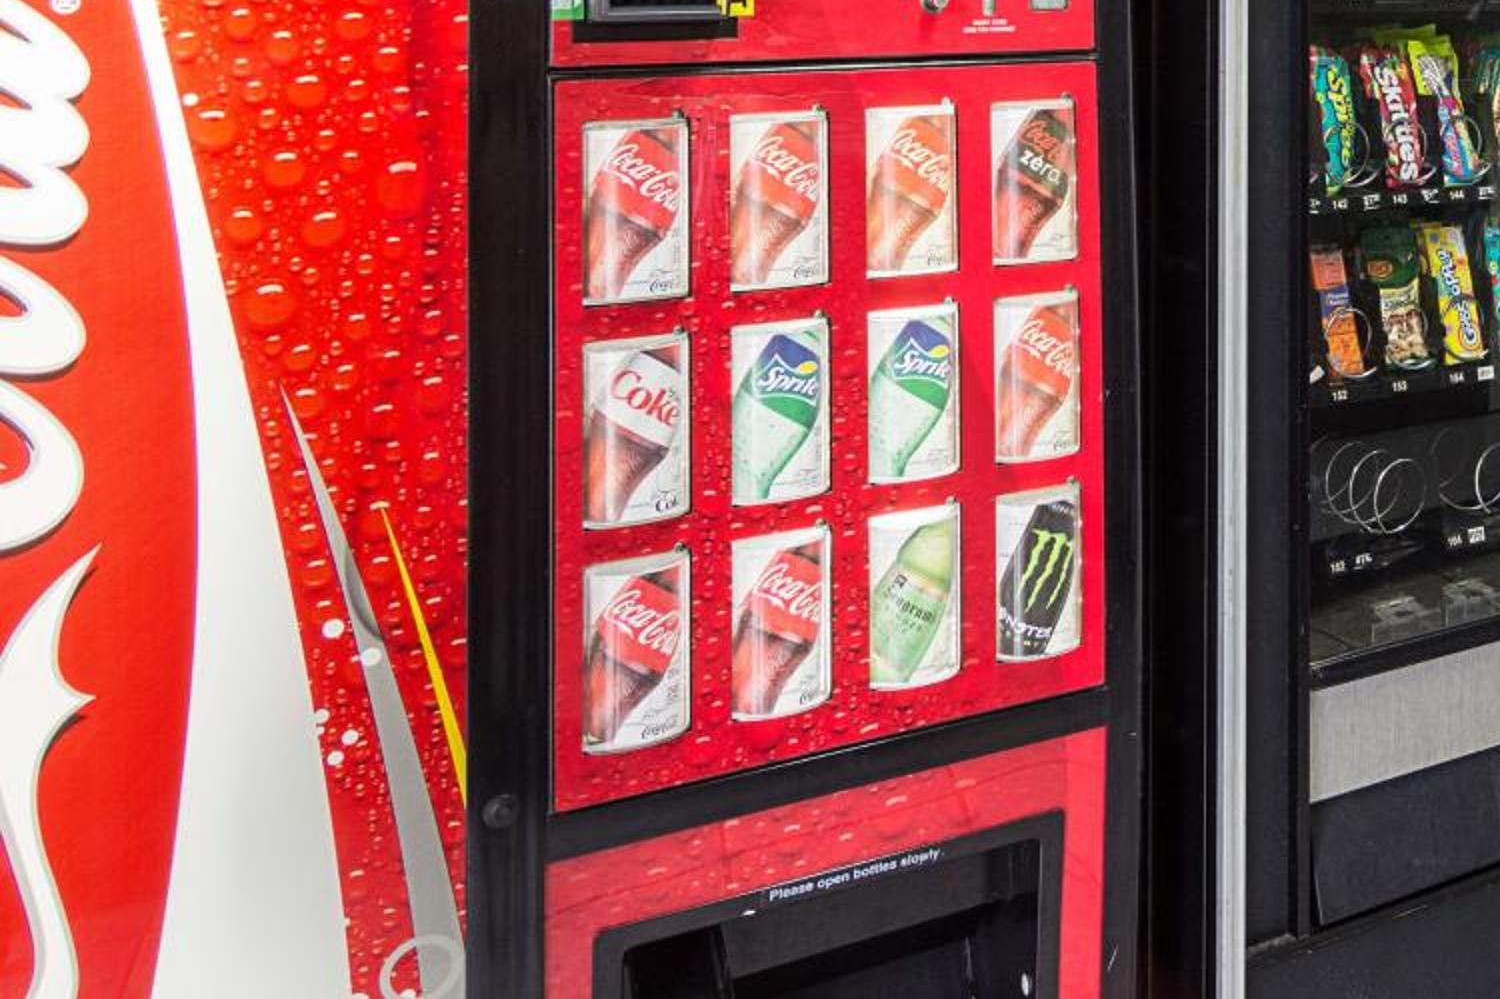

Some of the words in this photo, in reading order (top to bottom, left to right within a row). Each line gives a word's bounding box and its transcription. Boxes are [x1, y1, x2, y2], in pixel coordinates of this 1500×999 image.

[1374, 64, 1419, 181] Skittles
[1020, 149, 1061, 185] zero
[1438, 249, 1479, 346] Gobsopper
[611, 369, 680, 427] Coke
[759, 366, 819, 397] Sprite
[770, 881, 813, 902] Please
[817, 872, 850, 890] open
[853, 860, 897, 880] bottles
[901, 848, 941, 868] slowly
